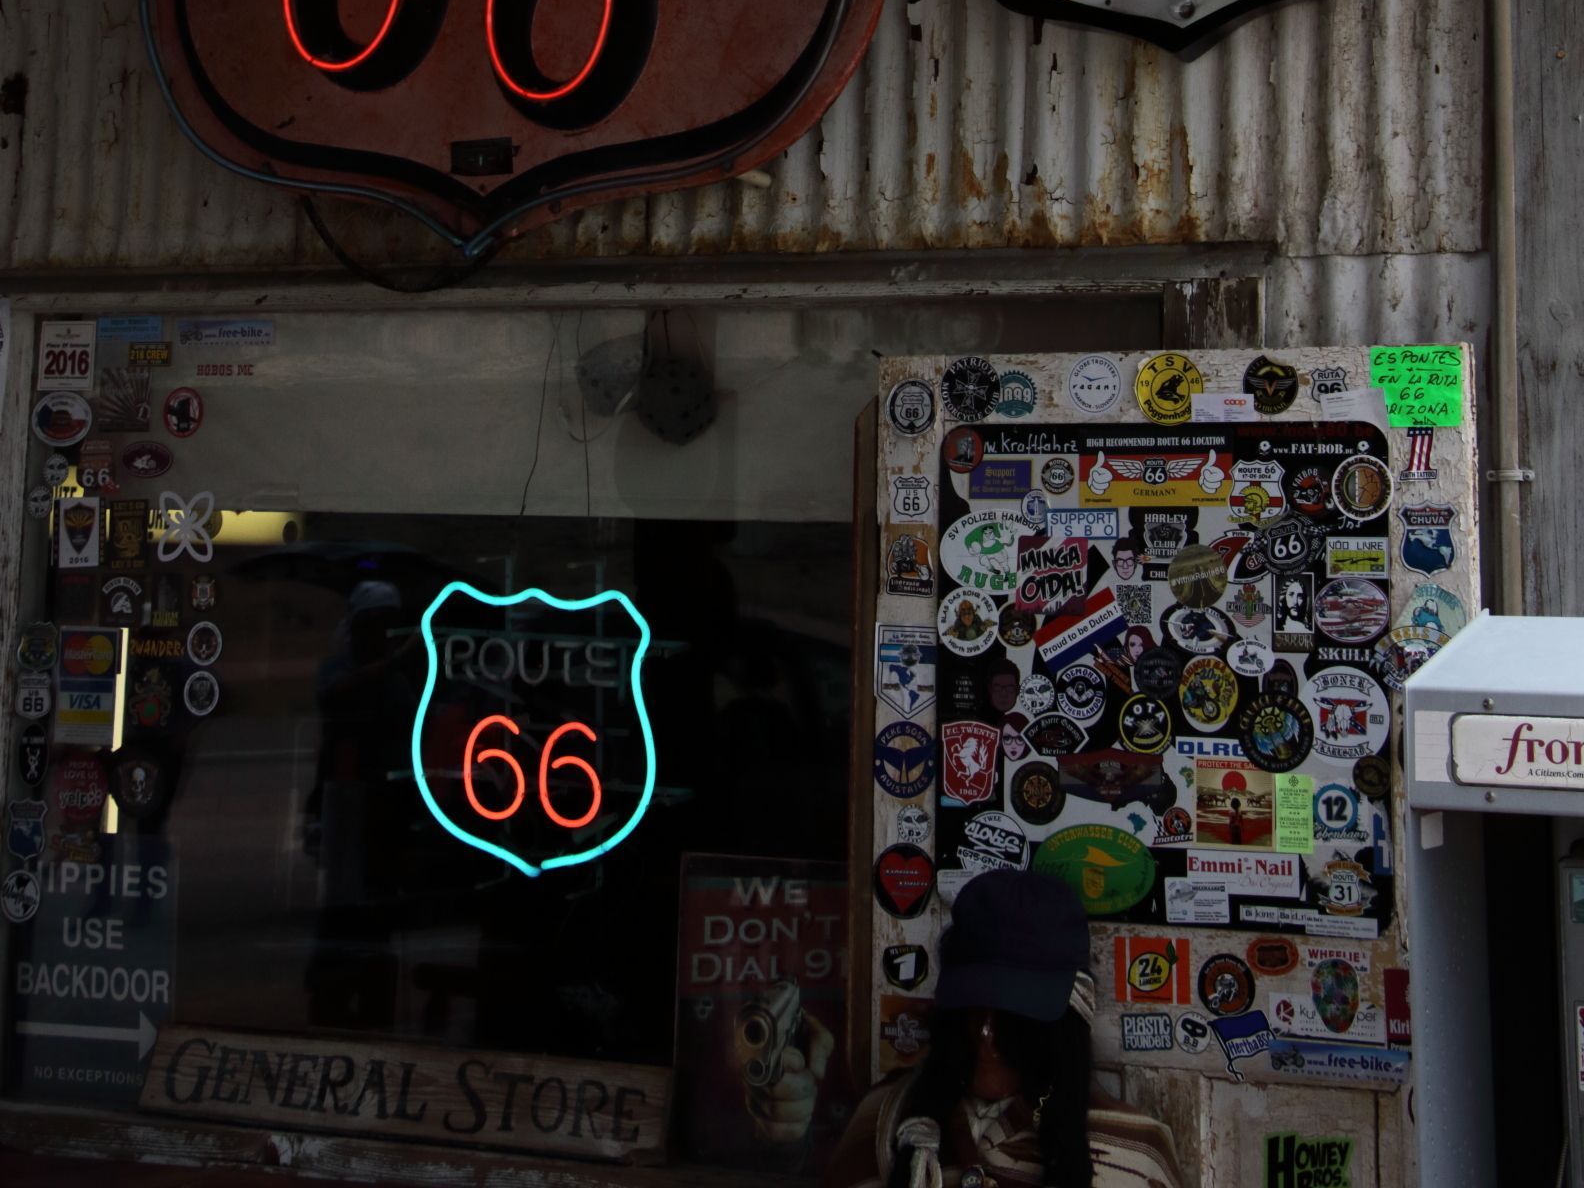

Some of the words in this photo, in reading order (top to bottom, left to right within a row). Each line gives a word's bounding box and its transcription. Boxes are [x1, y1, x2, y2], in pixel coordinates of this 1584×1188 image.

[44, 349, 90, 377] 2016
[237, 364, 254, 377] MC
[950, 356, 998, 383] PATRIOTS
[1317, 371, 1342, 379] RUTA
[1399, 387, 1425, 401] 66
[905, 407, 919, 419] 66
[1105, 436, 1156, 447] RECOMMENDED
[1157, 436, 1180, 447] ROUTE
[1181, 436, 1191, 446] 66
[1192, 435, 1226, 446] LOCATION
[82, 467, 111, 488] 66
[985, 467, 1016, 478] Support
[1053, 469, 1065, 481] 66
[1144, 468, 1165, 483] 66
[1264, 465, 1276, 474] 66
[1133, 487, 1177, 497] GERMANY
[902, 496, 920, 512] 66
[961, 511, 997, 528] POLIZEI
[1001, 511, 1043, 533] HAMBUR
[1050, 512, 1114, 525] SUPPORT
[1144, 513, 1187, 524] HARLEY
[1410, 516, 1446, 525] CHUVA
[1153, 540, 1176, 549] CLUB
[1274, 534, 1302, 558] 66
[1356, 541, 1384, 551] LIVRE
[1020, 545, 1081, 572] MINGA
[957, 564, 1018, 591] RUGB
[1149, 570, 1168, 579] CHIL
[947, 592, 961, 606] DAS
[962, 590, 981, 599] ROHR
[1042, 639, 1068, 657] Proud
[1068, 632, 1077, 641] to
[1077, 626, 1089, 636] be
[1088, 612, 1114, 630] Dutch
[444, 634, 619, 688] ROUTE
[22, 696, 45, 712] 66
[69, 694, 101, 710] VISA
[1123, 702, 1166, 727] ROTA
[960, 726, 996, 740] TWENTE
[69, 761, 96, 771] PEOPLE
[462, 713, 603, 829] 66
[1527, 768, 1534, 776] A
[1535, 768, 1565, 778] Citizens
[64, 770, 87, 780] LOVE
[88, 770, 98, 780] US
[58, 788, 88, 810] yelp
[1321, 795, 1348, 822] 12
[37, 860, 168, 900] IPPIES
[1332, 873, 1355, 882] ROUTE
[732, 876, 809, 907] WE
[1334, 885, 1353, 902] 31
[62, 916, 125, 950] USE
[703, 913, 842, 948] DON'T
[690, 950, 780, 984] DIAL
[1138, 956, 1163, 978] 24
[16, 962, 170, 1004] BACKDOOR
[33, 1065, 53, 1080] NO
[57, 1065, 145, 1087] EXCEPTIONS
[164, 1037, 429, 1123] GENERAL
[443, 1060, 647, 1143] STORE
